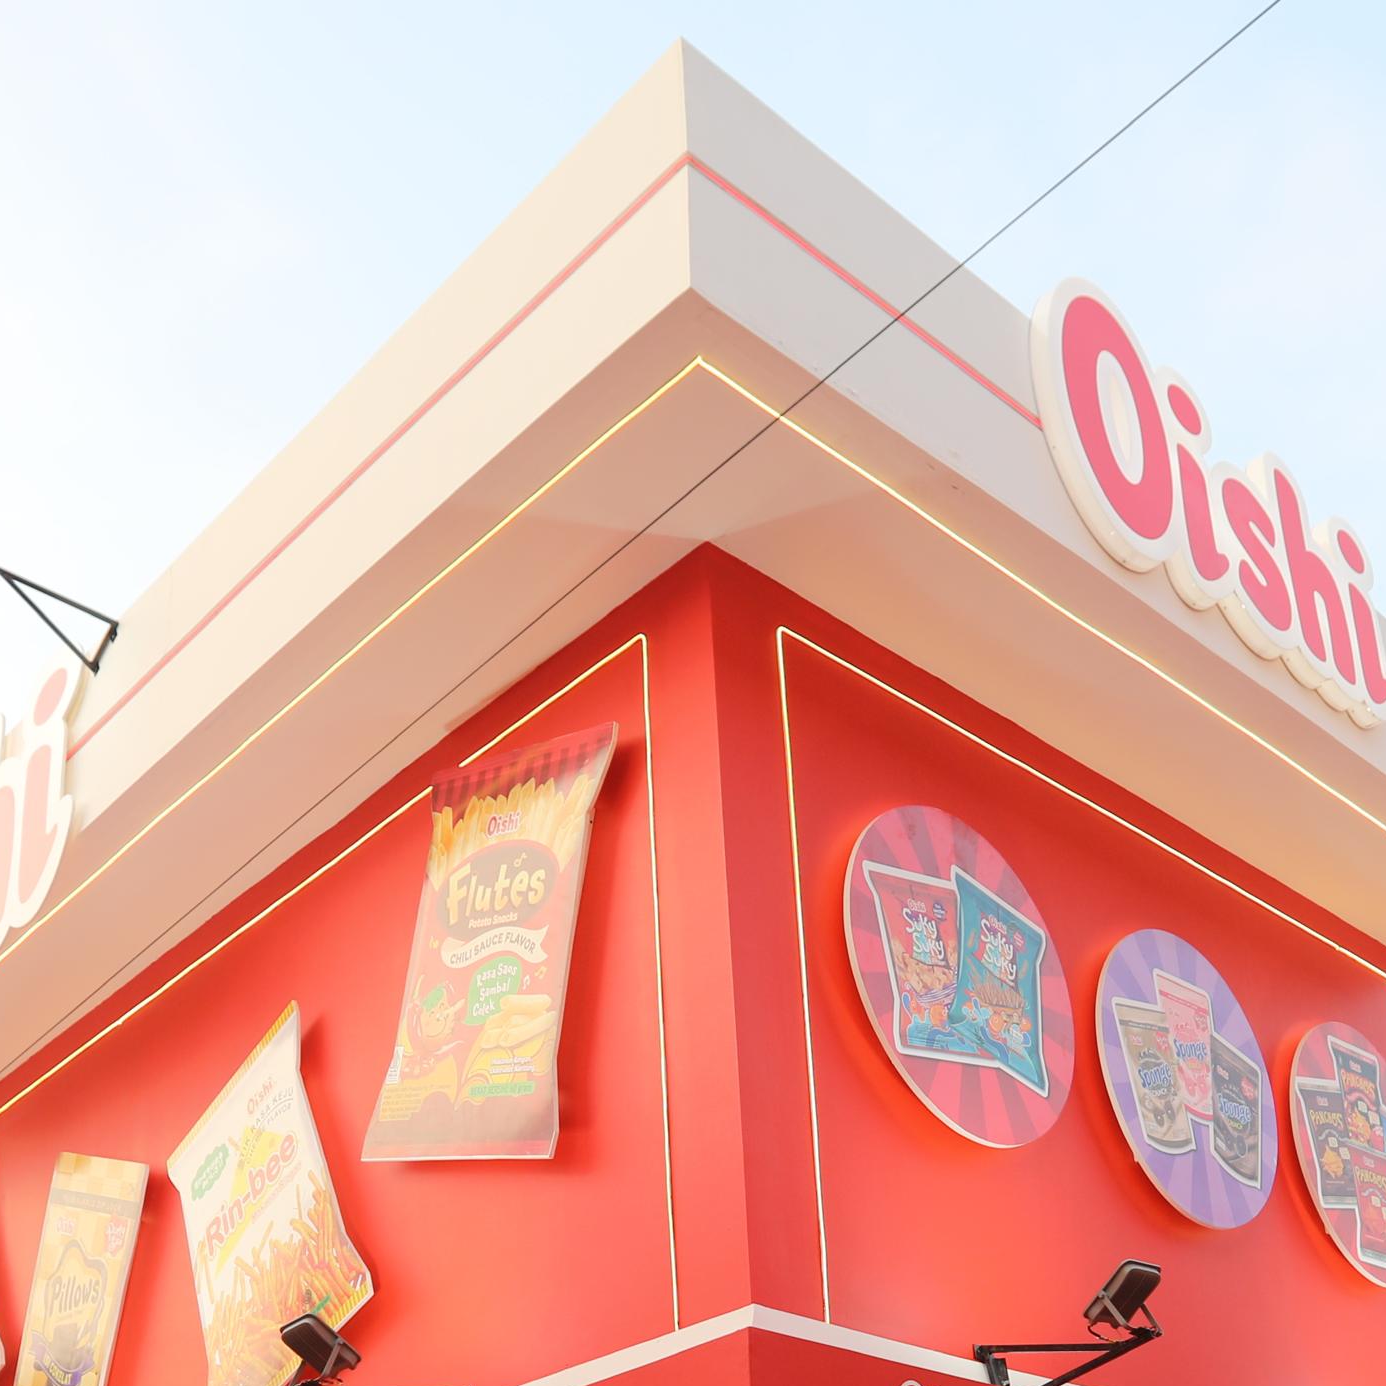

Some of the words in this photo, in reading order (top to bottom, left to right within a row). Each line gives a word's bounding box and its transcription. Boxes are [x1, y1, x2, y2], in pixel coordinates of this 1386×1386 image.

[486, 812, 521, 837] Oishi
[447, 863, 546, 925] Flutes
[468, 917, 492, 928] Potato
[493, 912, 517, 925] Snacks
[449, 948, 473, 965] CHILI
[474, 932, 504, 956] SAUCE
[505, 932, 536, 954] FLAVOR
[476, 970, 496, 987] Rasa
[497, 963, 517, 978] Saos
[1174, 1039, 1207, 1061] Sponge
[1138, 1063, 1171, 1090] Sponge
[247, 1077, 274, 1115] Oishi
[1219, 1098, 1252, 1124] Sponge
[1310, 1109, 1344, 1130] PANCHOS
[205, 1132, 297, 1258] Rin-bee
[50, 1275, 100, 1316] Pillows
